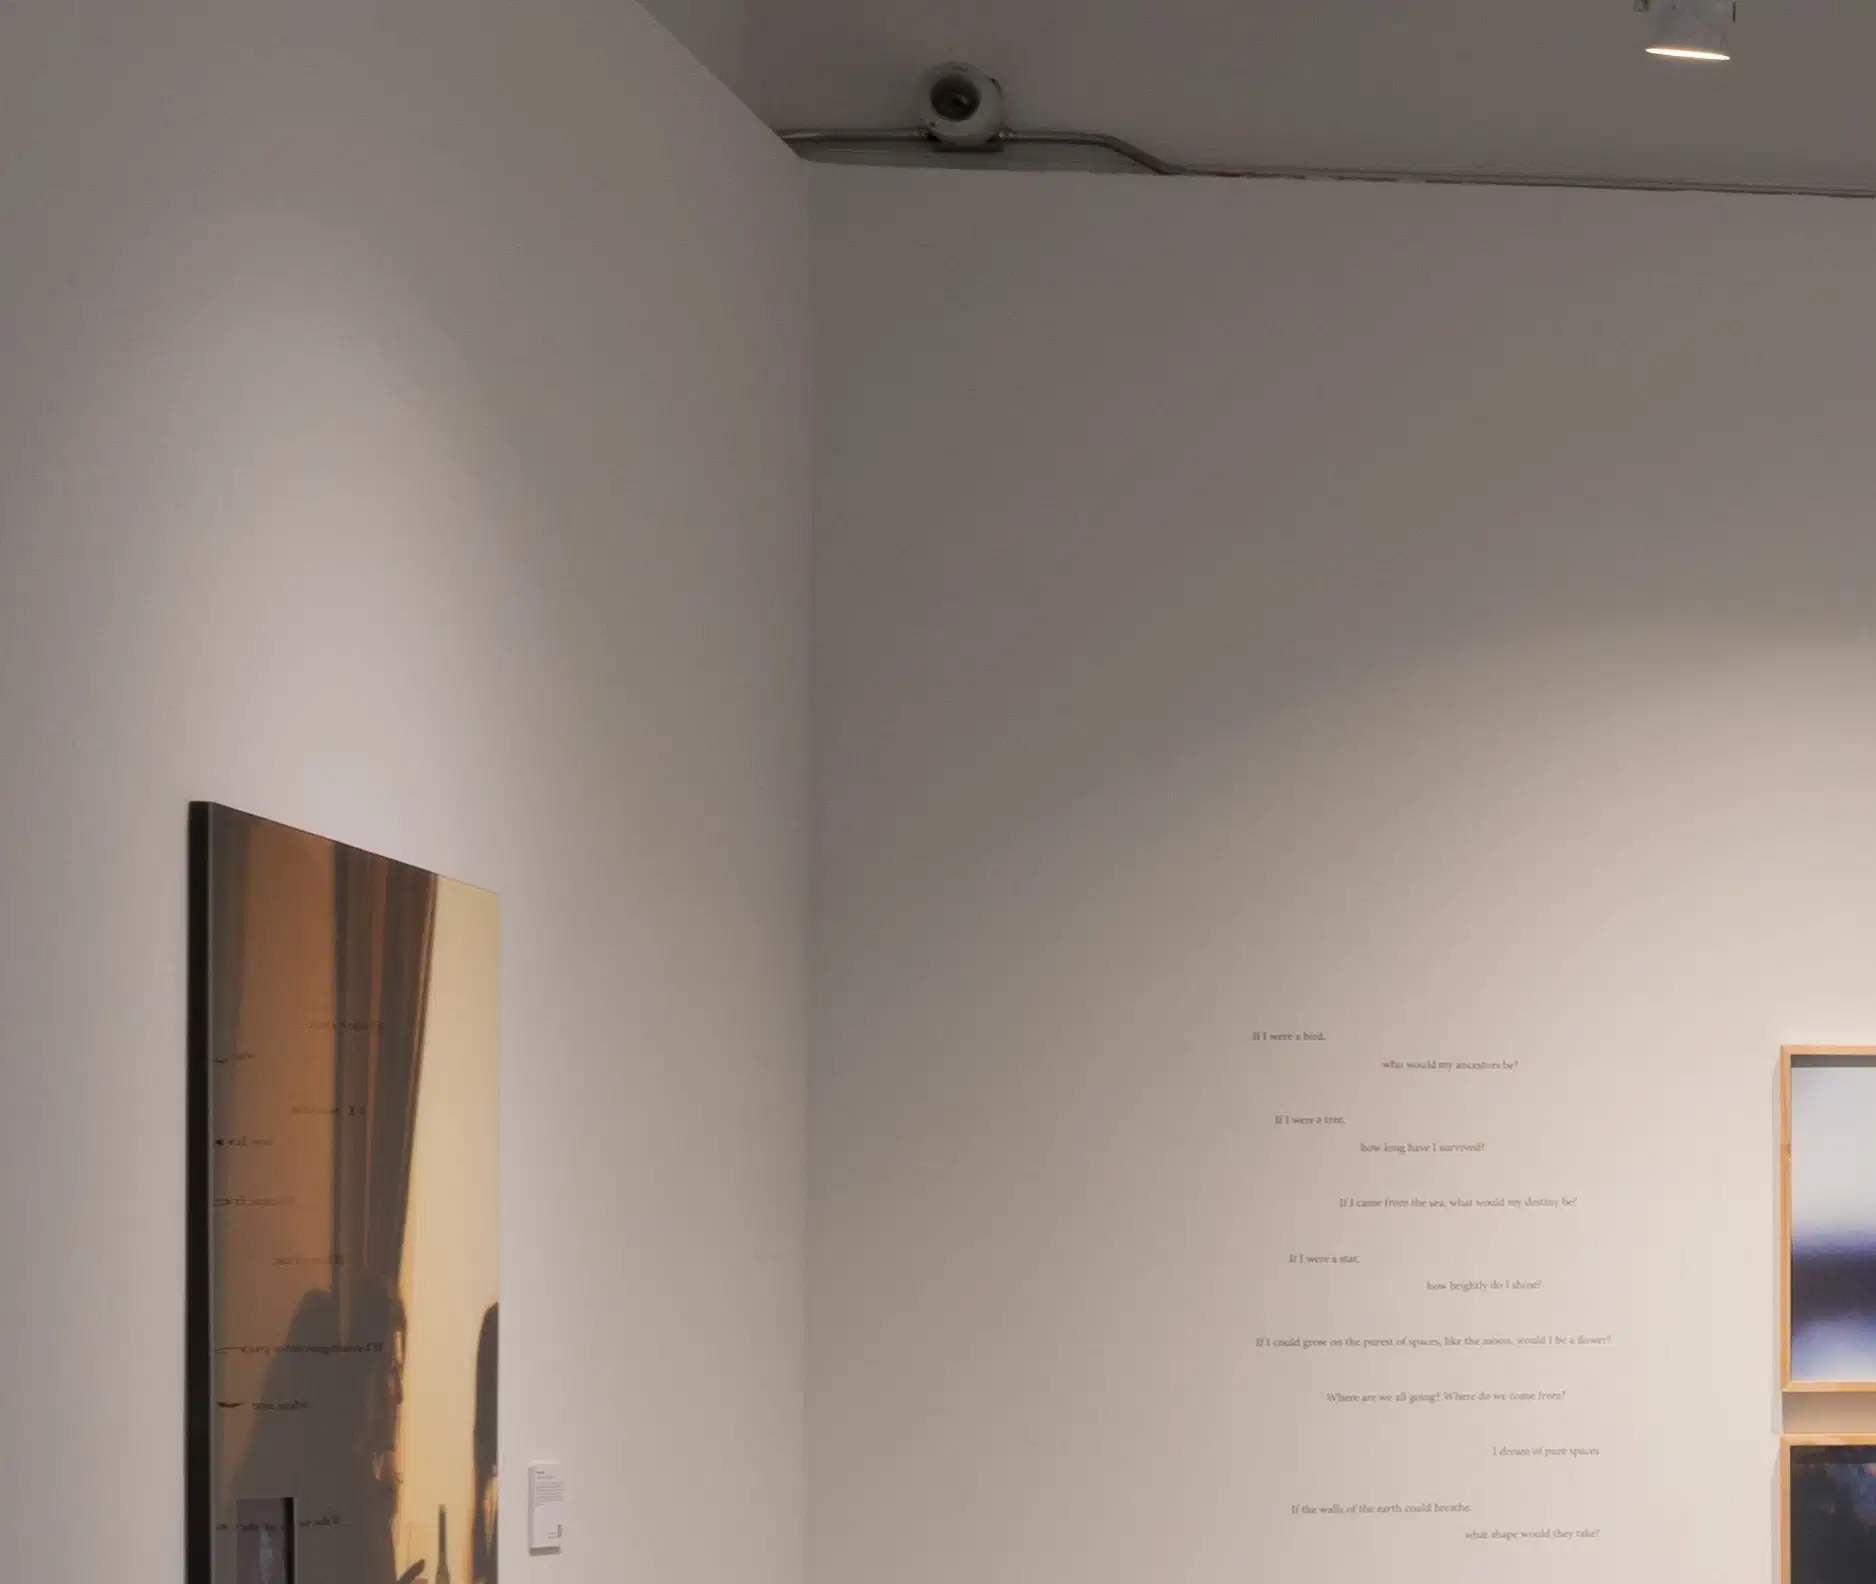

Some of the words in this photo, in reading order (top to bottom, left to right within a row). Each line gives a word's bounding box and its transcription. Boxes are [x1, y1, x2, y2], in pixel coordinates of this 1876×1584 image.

[1252, 1031, 1261, 1041] If
[1269, 1033, 1293, 1041] were
[1381, 1059, 1404, 1069] what
[1406, 1059, 1436, 1070] would
[1438, 1061, 1452, 1073] my
[1502, 1059, 1519, 1070] be?
[1274, 1114, 1284, 1125] If
[1292, 1117, 1314, 1125] were
[1360, 1142, 1381, 1153] how
[1384, 1142, 1406, 1156] long
[1407, 1143, 1430, 1153] have
[1339, 1196, 1349, 1209] If
[1356, 1199, 1381, 1208] came
[1384, 1197, 1408, 1208] from
[1411, 1197, 1427, 1208] the
[1449, 1197, 1472, 1208] what
[1476, 1197, 1504, 1208] would
[1508, 1199, 1522, 1209] my
[1525, 1196, 1560, 1209] destiny
[1561, 1195, 1577, 1206] be?
[1288, 1253, 1298, 1264] If
[1305, 1256, 1330, 1264] were
[1425, 1280, 1447, 1291] how
[1449, 1279, 1487, 1293] brightly
[1490, 1279, 1503, 1290] do
[1256, 1336, 1266, 1349] If
[1272, 1336, 1300, 1349] could
[1302, 1339, 1327, 1350] grow
[1329, 1339, 1343, 1347] on
[1345, 1336, 1361, 1347] the
[1363, 1338, 1393, 1349] purest
[1396, 1335, 1407, 1346] of
[1444, 1335, 1463, 1346] like
[1464, 1335, 1480, 1346] the
[1516, 1335, 1546, 1345] would
[1555, 1335, 1567, 1345] be
[1326, 1391, 1358, 1404] Where
[1361, 1394, 1377, 1403] are
[1395, 1391, 1407, 1402] all
[1443, 1391, 1477, 1401] Where
[1478, 1391, 1490, 1401] do
[1493, 1393, 1506, 1401] we
[1509, 1392, 1536, 1401] come
[1538, 1390, 1566, 1401] from?
[1499, 1445, 1530, 1457] dream
[1532, 1447, 1542, 1456] of
[1544, 1448, 1568, 1457] pure
[1291, 1503, 1300, 1515] If
[1301, 1504, 1317, 1515] the
[1318, 1503, 1344, 1514] walls
[1346, 1503, 1357, 1514] of
[1359, 1503, 1376, 1514] the
[1377, 1503, 1402, 1513] earth
[1404, 1502, 1432, 1513] could
[1464, 1529, 1488, 1540] what
[1491, 1529, 1519, 1542] shape
[1520, 1527, 1550, 1539] would
[1553, 1528, 1573, 1541] they
[1575, 1528, 1600, 1538] take?
